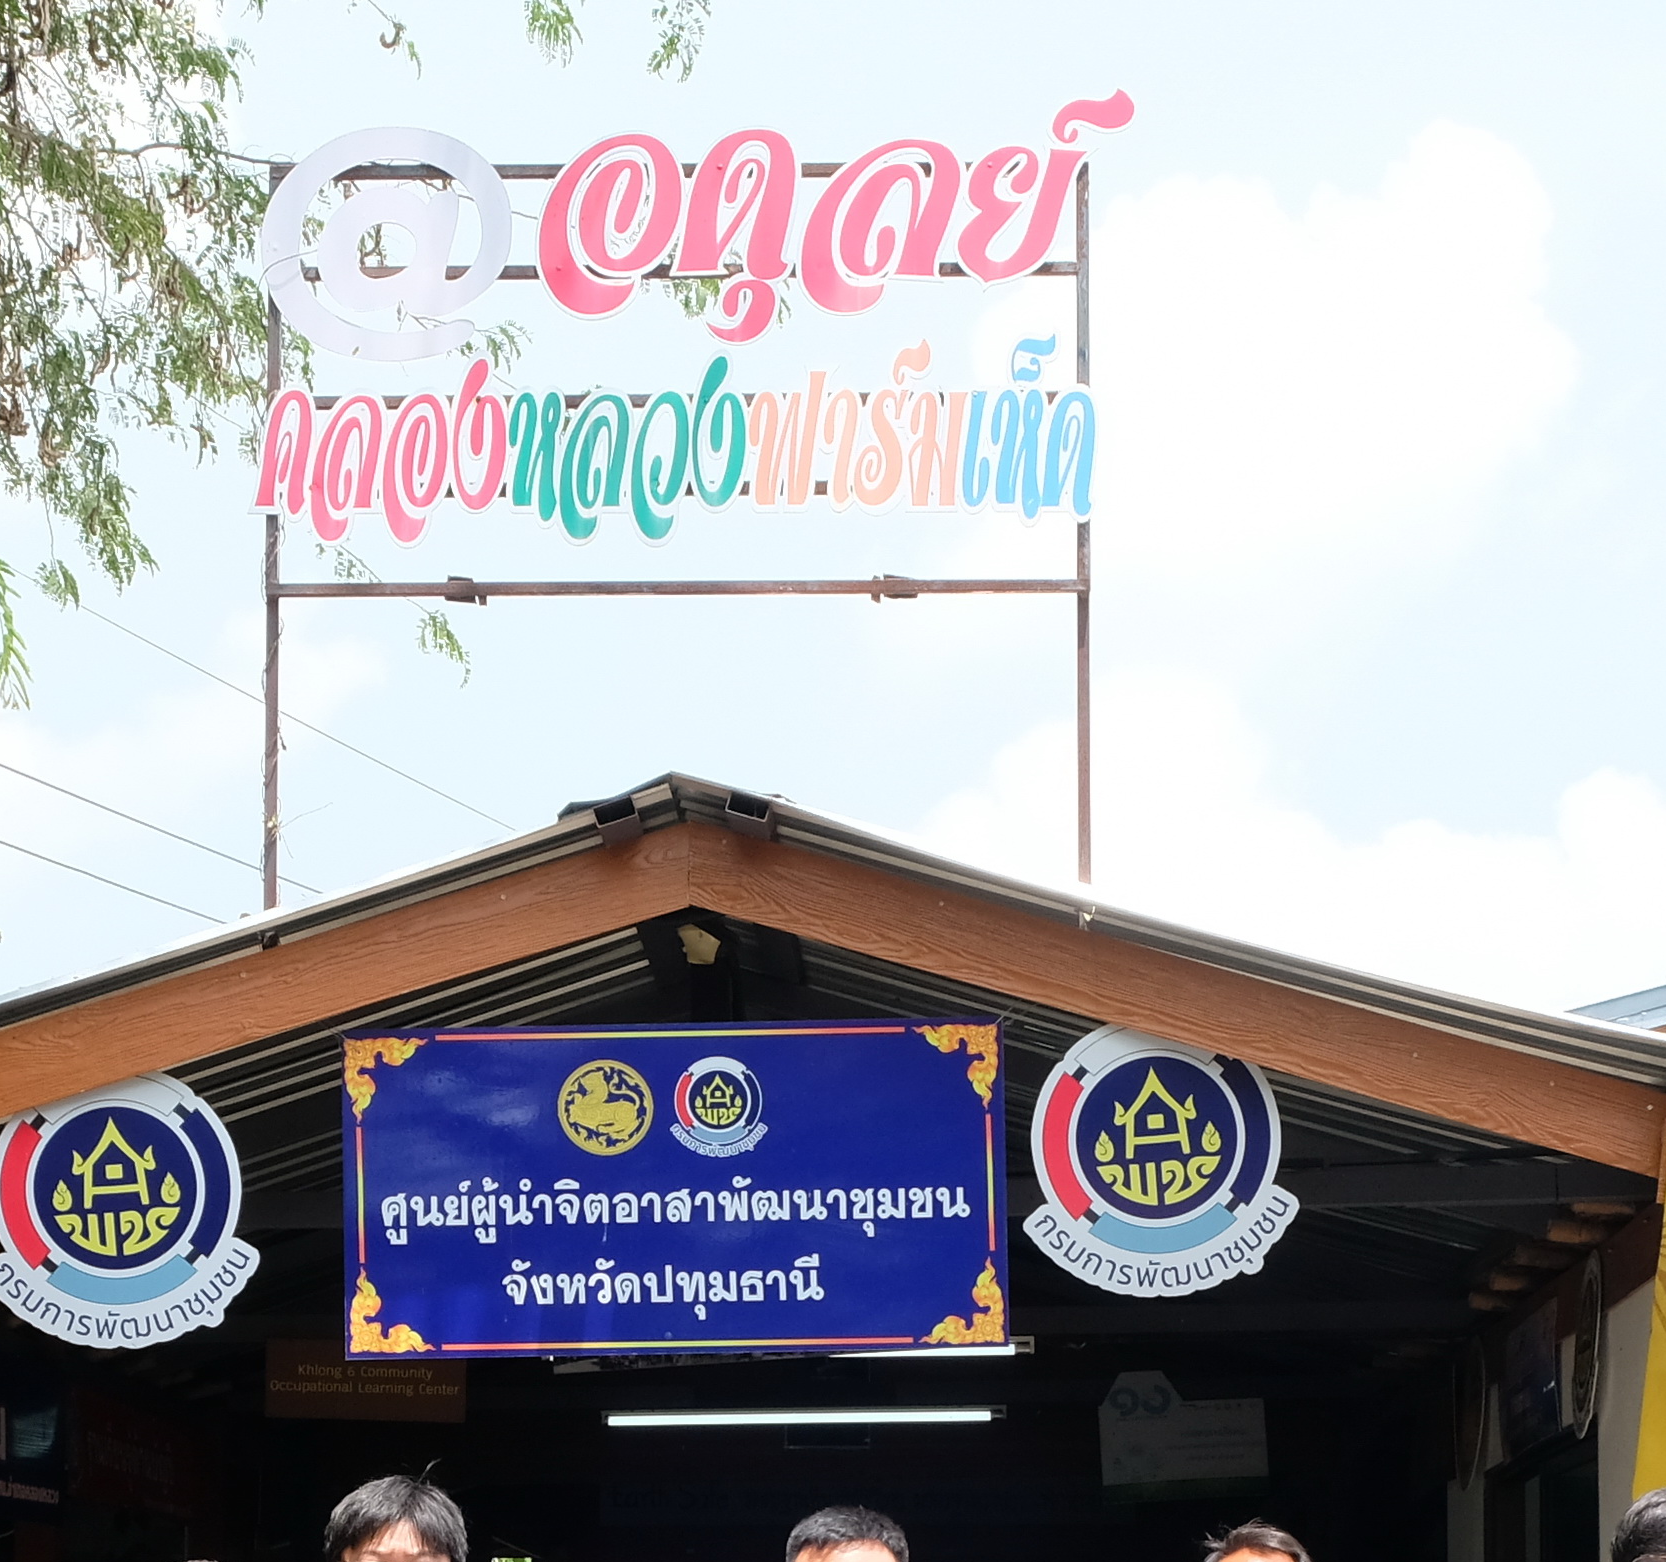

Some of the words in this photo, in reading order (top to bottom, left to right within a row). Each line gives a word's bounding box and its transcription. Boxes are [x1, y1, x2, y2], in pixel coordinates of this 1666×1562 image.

[261, 127, 512, 361] @
[537, 88, 1134, 346] อดุลย์
[247, 332, 1096, 547] คลองหลวงฟาร์มเห็ด
[671, 1123, 768, 1157] กรมการพัฒนาชุมชน
[379, 1175, 971, 1245] ศูนย์ผู้นำจิตอาสาพัฒนาชุมชน
[1033, 1195, 1290, 1288] กรมการพัฒนาชุมชน
[502, 1253, 825, 1321] จังหวัดปทุมธานี
[269, 1379, 353, 1394] Occupational
[358, 1383, 414, 1397] Learning
[418, 1383, 460, 1396] Center
[298, 1364, 343, 1380] Khlong
[347, 1366, 355, 1377] 6
[360, 1365, 433, 1381] Community
